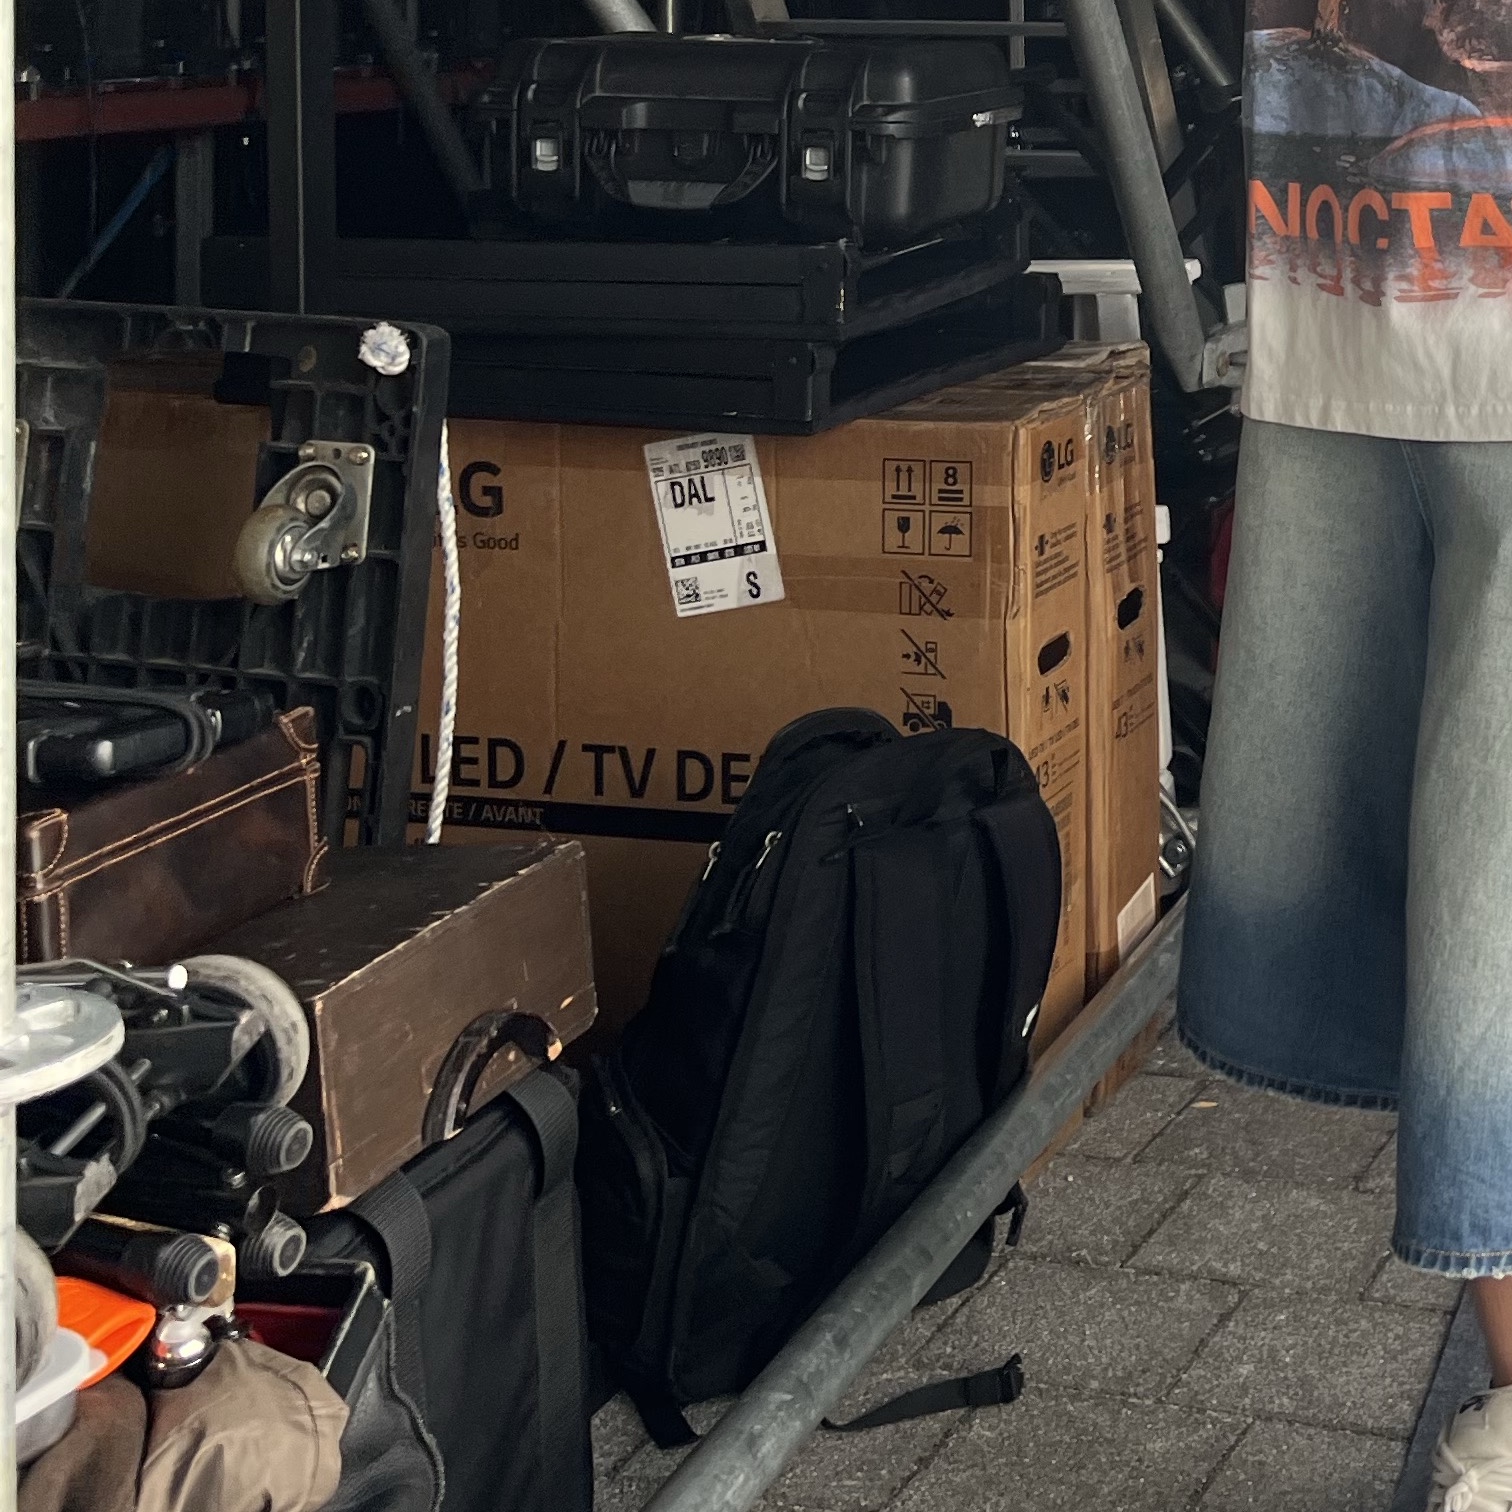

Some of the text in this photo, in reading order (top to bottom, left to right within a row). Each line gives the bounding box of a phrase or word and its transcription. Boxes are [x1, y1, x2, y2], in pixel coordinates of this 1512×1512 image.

[1057, 438, 1074, 470] LG
[436, 461, 504, 518] G
[944, 466, 958, 486] 8
[670, 476, 715, 508] DAL
[473, 532, 520, 551] Good
[746, 571, 761, 599] S
[421, 734, 525, 789] LED
[543, 740, 567, 795] /
[581, 744, 656, 798] TV
[481, 804, 544, 825] AVANT
